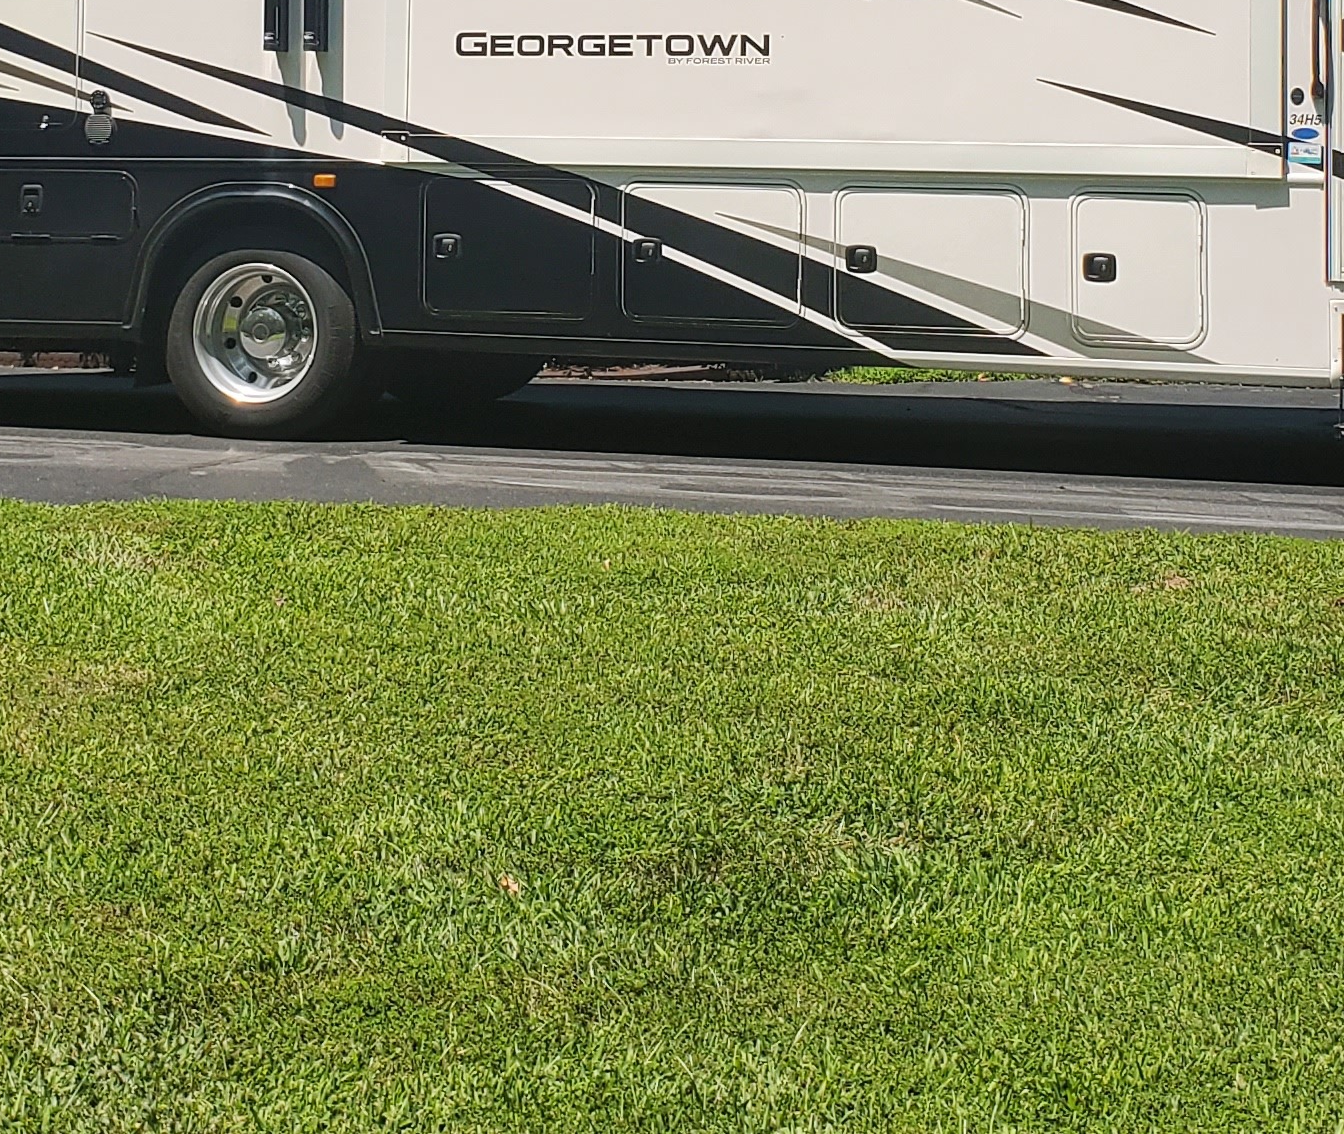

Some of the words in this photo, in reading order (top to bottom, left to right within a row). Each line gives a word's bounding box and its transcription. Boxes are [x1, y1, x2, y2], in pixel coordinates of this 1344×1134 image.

[455, 32, 770, 57] GEORGETOWN
[667, 57, 684, 65] BY
[686, 57, 733, 65] FOREST
[735, 57, 771, 65] RIVER
[1289, 113, 1323, 126] 34H5
